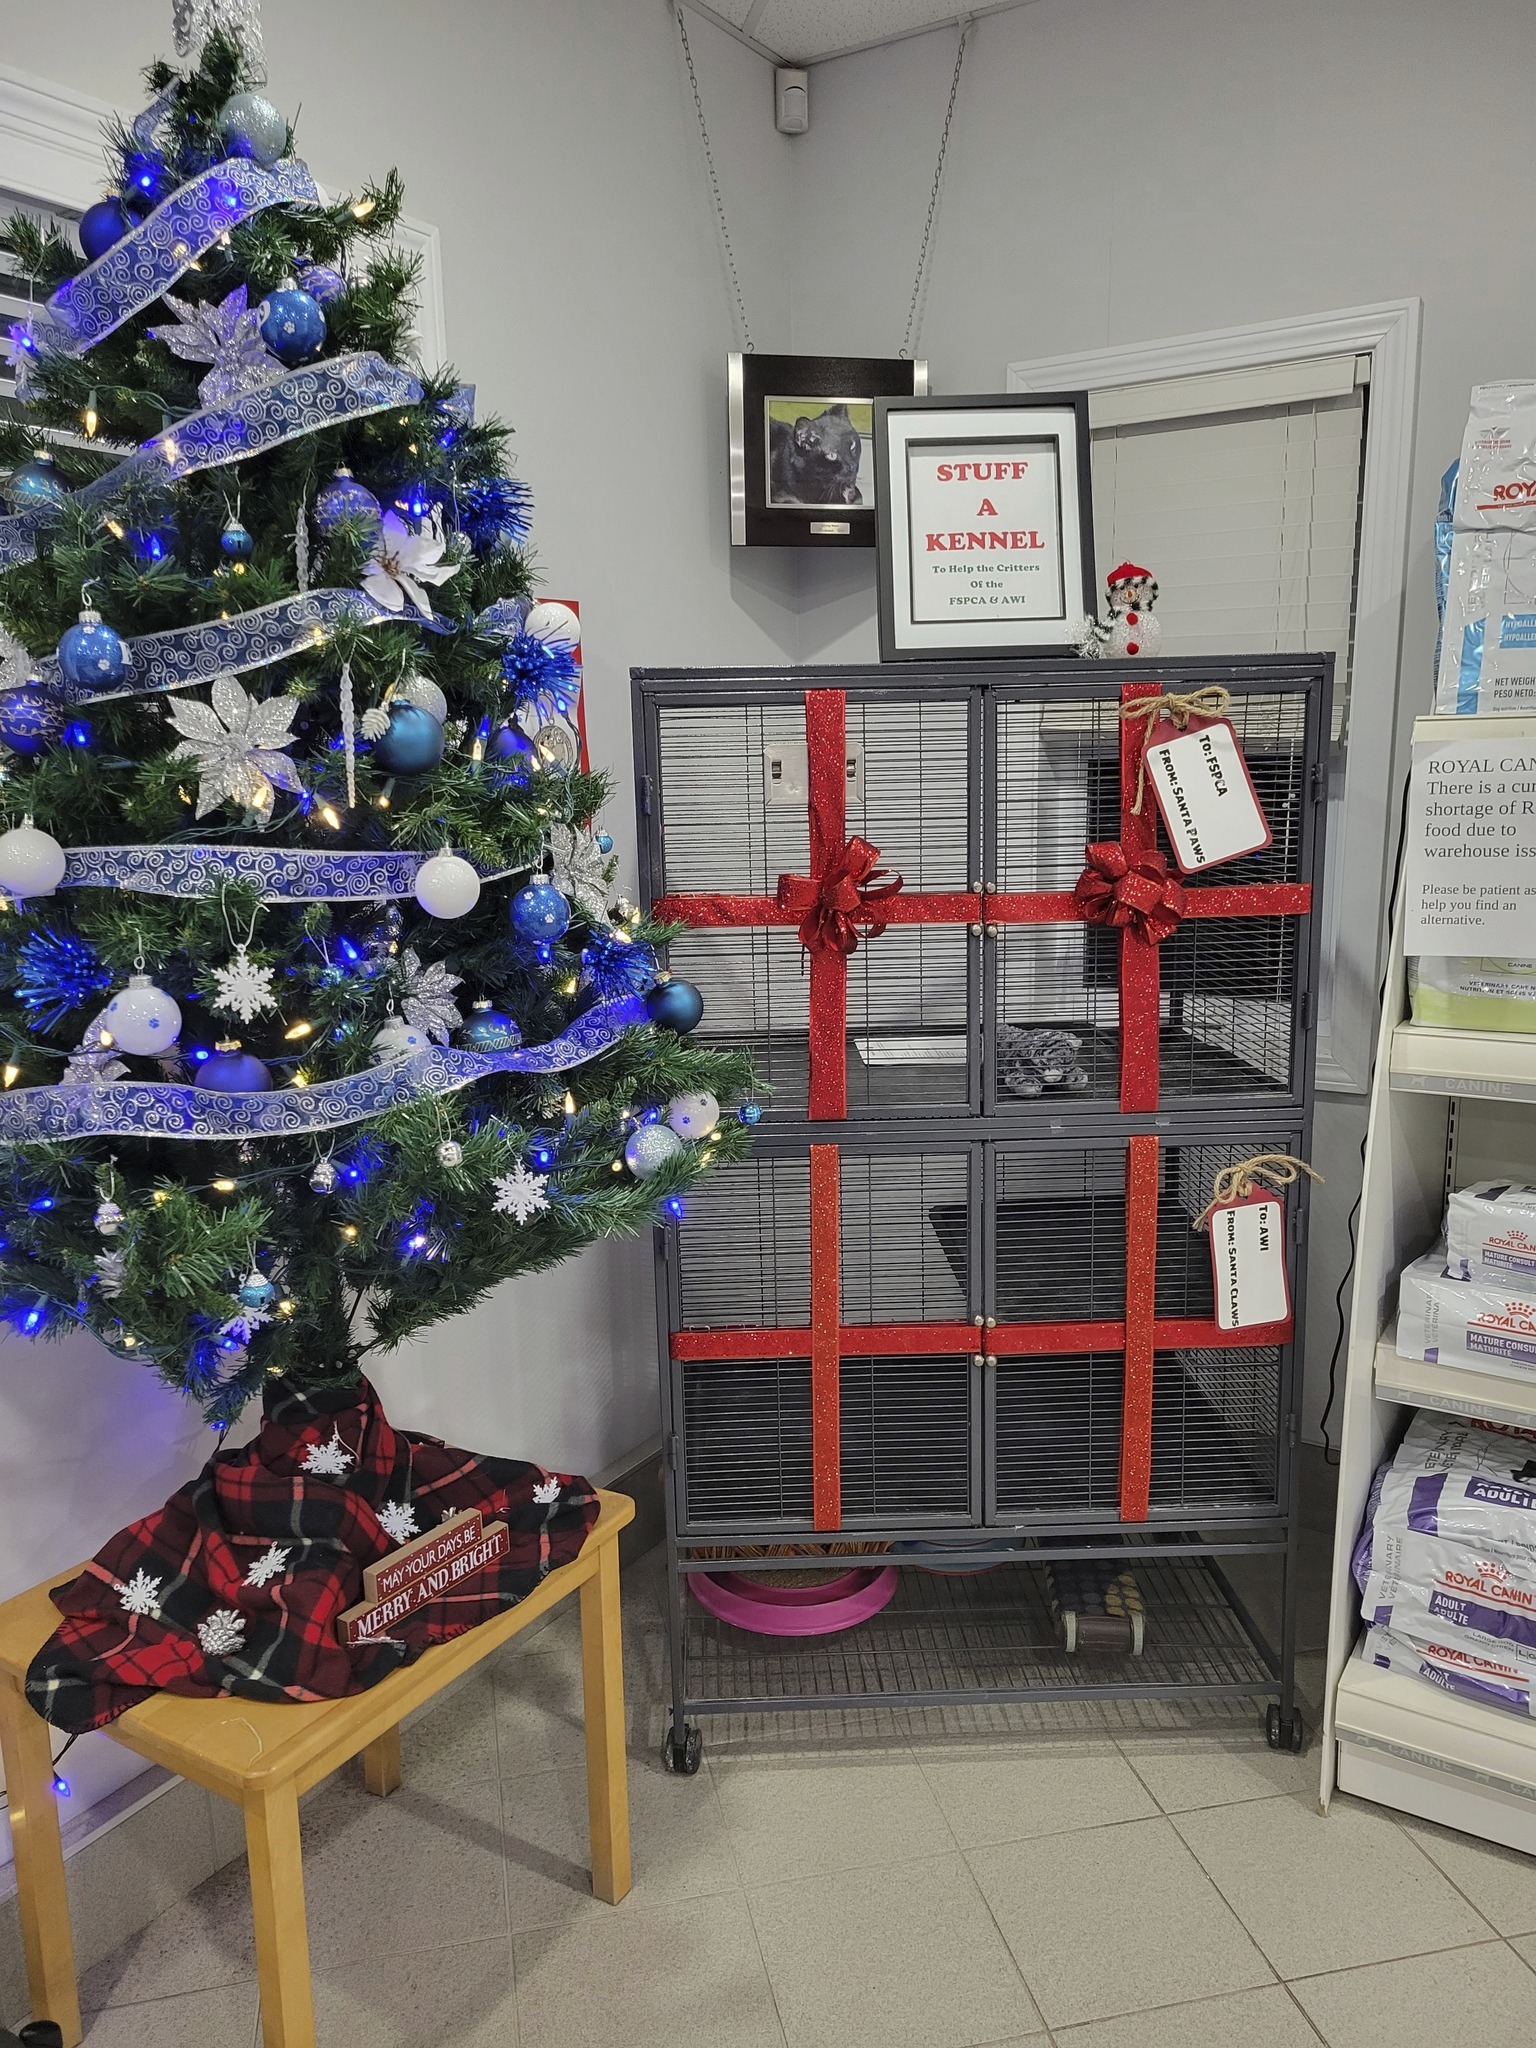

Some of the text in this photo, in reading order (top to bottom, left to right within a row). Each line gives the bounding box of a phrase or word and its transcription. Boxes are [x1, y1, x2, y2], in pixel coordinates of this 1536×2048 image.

[937, 462, 1028, 481] STUFF
[976, 498, 998, 516] A
[925, 531, 1045, 551] KENNEL
[932, 564, 1040, 574] To Help the Critters
[970, 580, 1003, 588] Of the
[949, 595, 1026, 605] FSPCA & AWI
[1505, 619, 1536, 628] HYPOALL
[1495, 678, 1509, 687] NET
[1493, 689, 1513, 699] PESO
[1428, 759, 1495, 774] ROYAL
[1206, 756, 1228, 797] FSPCA
[1427, 781, 1473, 795] There
[1478, 781, 1492, 794] is
[1497, 783, 1506, 794] a
[1159, 748, 1206, 864] FROM: SANTA PAWS
[1425, 802, 1493, 819] shortage
[1499, 800, 1517, 815] of
[1425, 822, 1517, 836] food due to
[1424, 844, 1510, 858] warehouse
[1422, 884, 1459, 895] Please
[1462, 884, 1476, 895] be
[1479, 885, 1520, 897] patient
[1421, 899, 1517, 912] help you find an
[1420, 914, 1485, 926] alternative.
[1445, 1078, 1513, 1095] CANINE
[1259, 1226, 1269, 1252] AWI
[1488, 1236, 1516, 1249] ROYAL
[1484, 1251, 1536, 1267] MATURE CONSULT
[1227, 1210, 1240, 1327] FROM: SANTA CLAWS
[1470, 1333, 1536, 1354] MATURE CONSU
[1470, 1342, 1513, 1357] MATURITÉ
[1429, 1396, 1494, 1417] CANINE
[382, 1525, 476, 1592] MAY YOUR DAYS BE
[356, 1533, 502, 1639] MERRY AND BRIGHT
[1445, 1570, 1488, 1593] ROYAL
[1434, 1595, 1467, 1611] ADULT
[1434, 1607, 1470, 1626] ADULTE
[1472, 1632, 1498, 1644] LARGE
[1427, 1645, 1471, 1664] ROYAL
[1388, 1743, 1455, 1772] CANINE
[1510, 1783, 1536, 1798] CA
